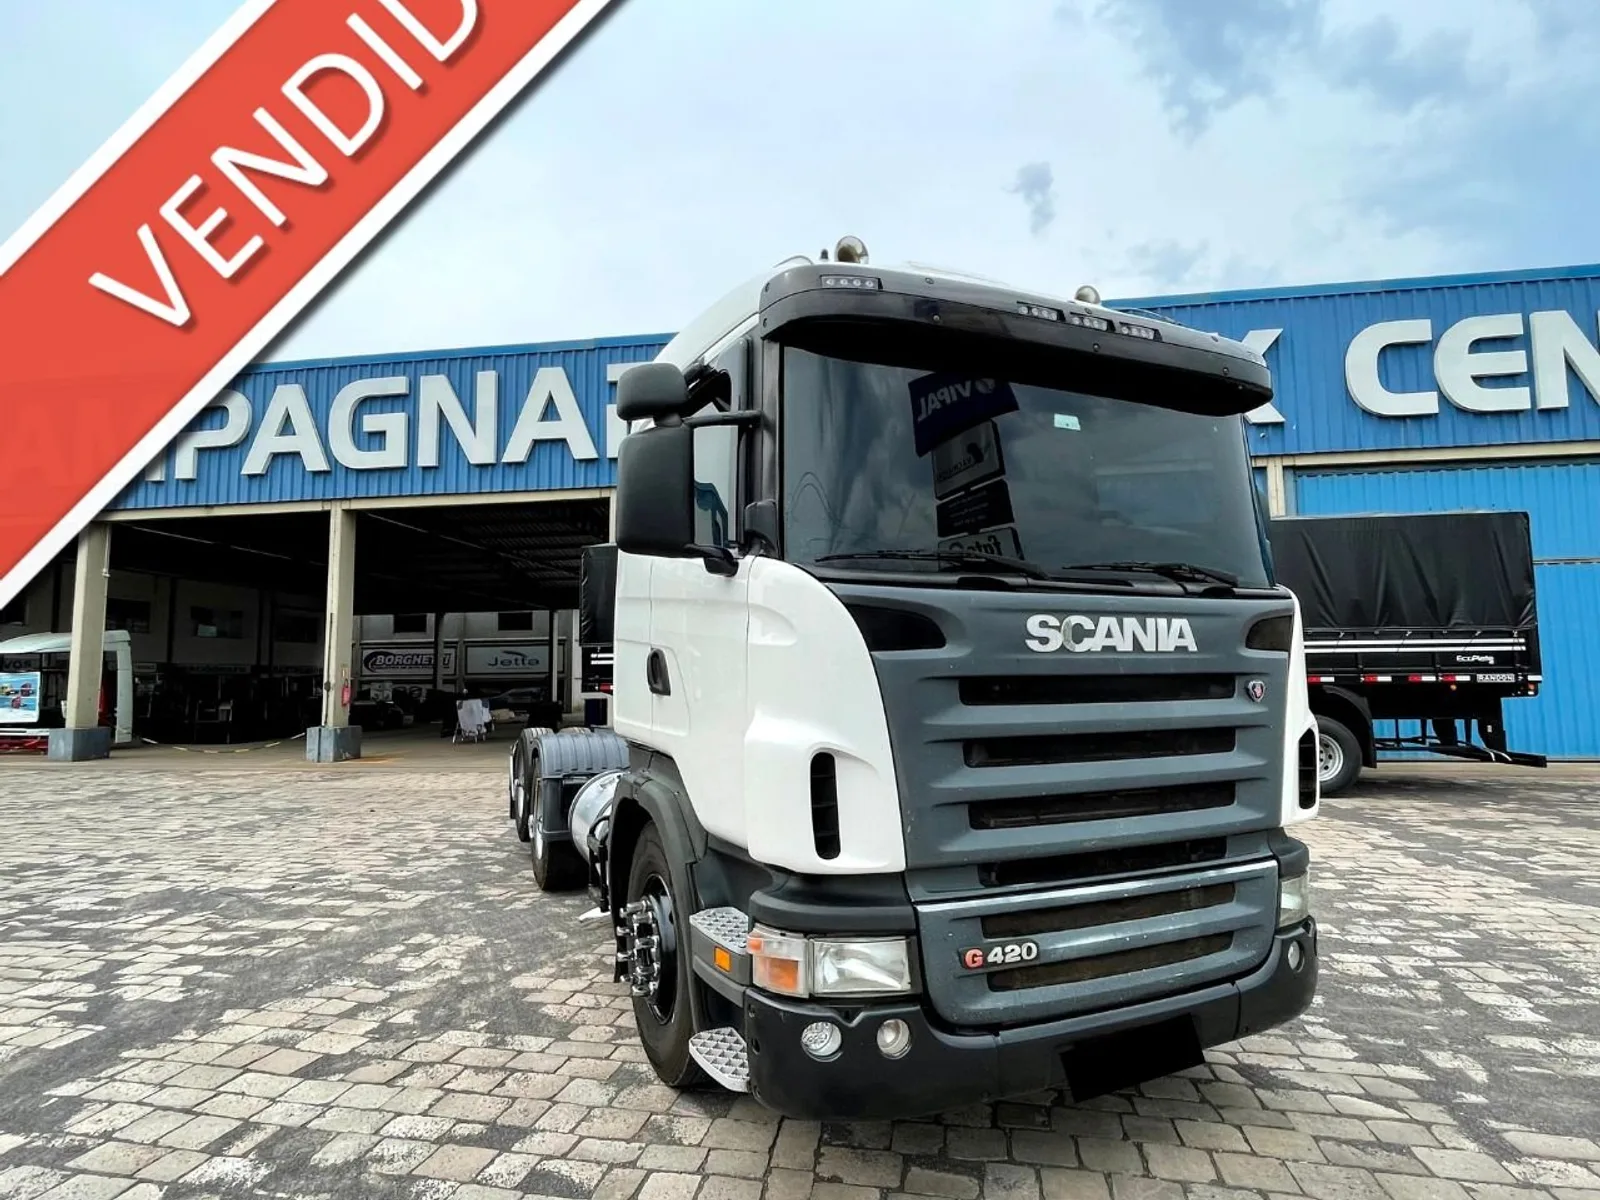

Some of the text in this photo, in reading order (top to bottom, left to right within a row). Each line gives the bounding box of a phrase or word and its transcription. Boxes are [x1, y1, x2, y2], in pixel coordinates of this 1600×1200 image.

[145, 362, 640, 482] PAGNA
[1025, 614, 1198, 652] SCANIA
[1478, 674, 1514, 682] RANDON
[964, 942, 1038, 968] G 420
